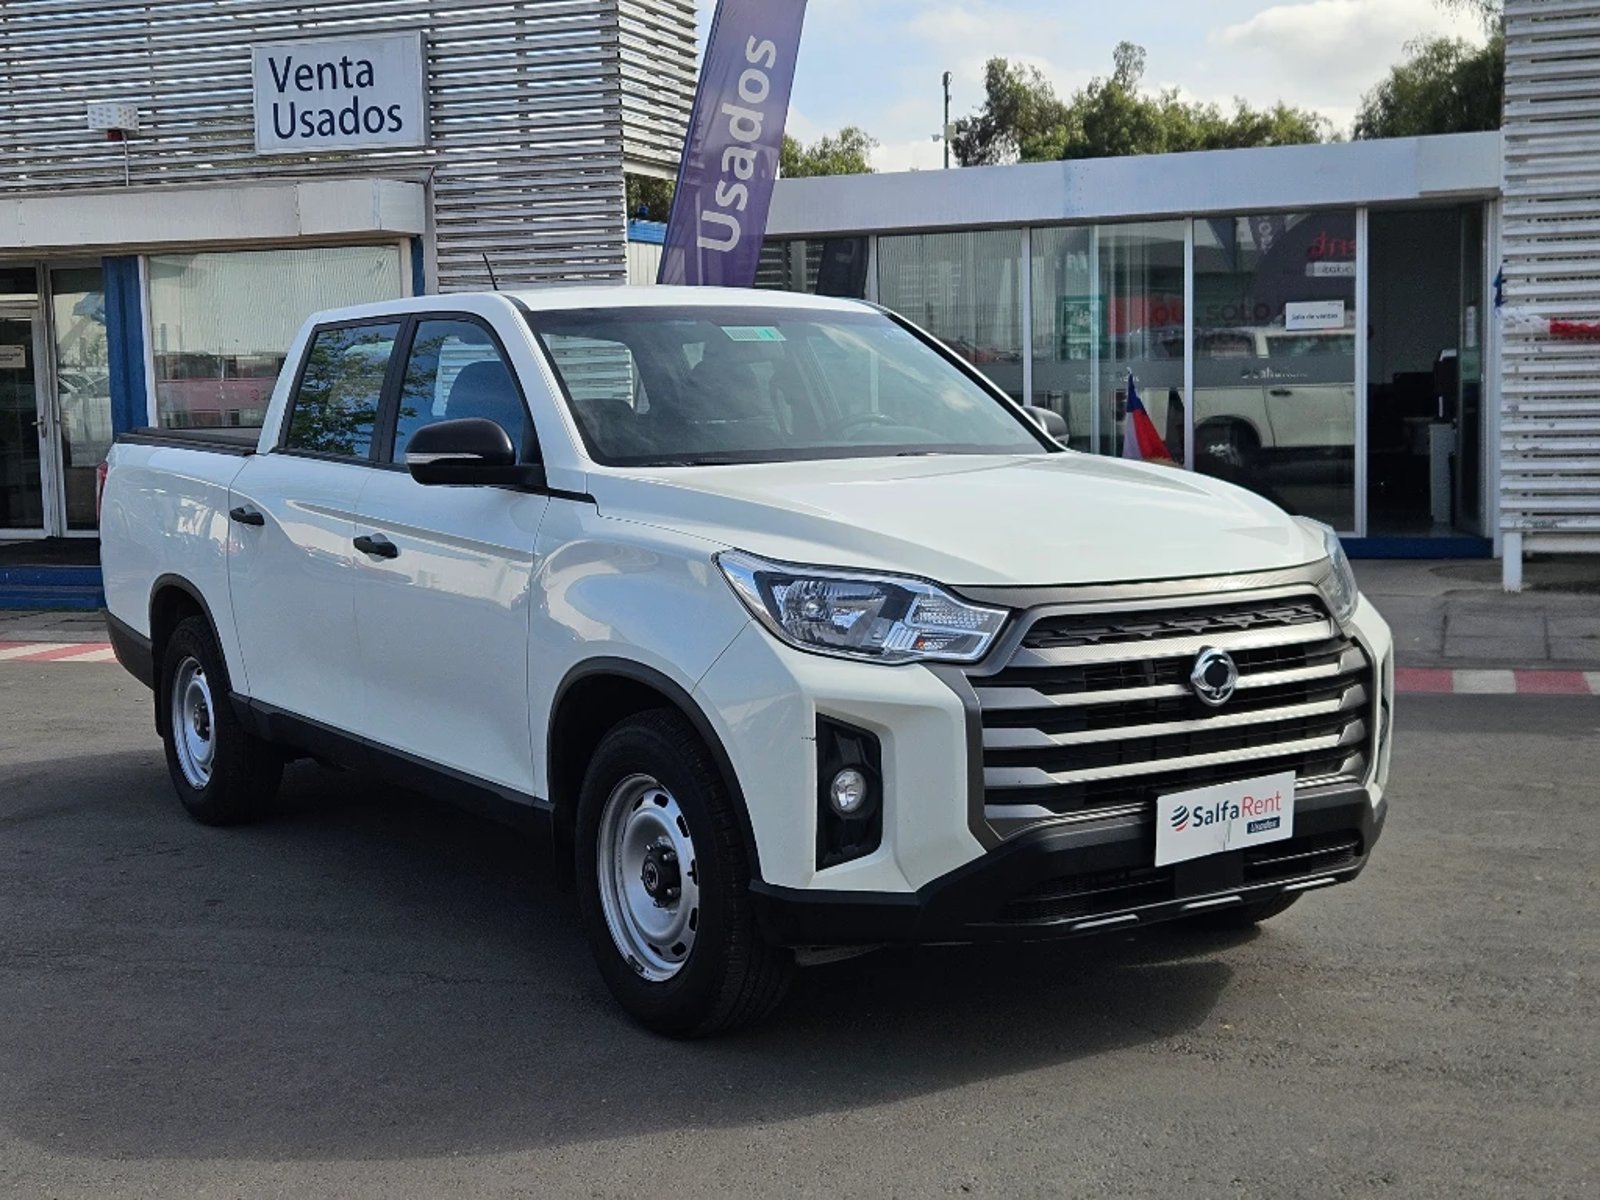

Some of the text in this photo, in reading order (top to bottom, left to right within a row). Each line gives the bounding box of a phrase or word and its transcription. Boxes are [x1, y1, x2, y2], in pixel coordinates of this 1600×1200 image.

[268, 56, 375, 93] Venta
[272, 95, 403, 140] Usados
[696, 35, 777, 252] Usados
[1192, 791, 1282, 828] SalfaRent
